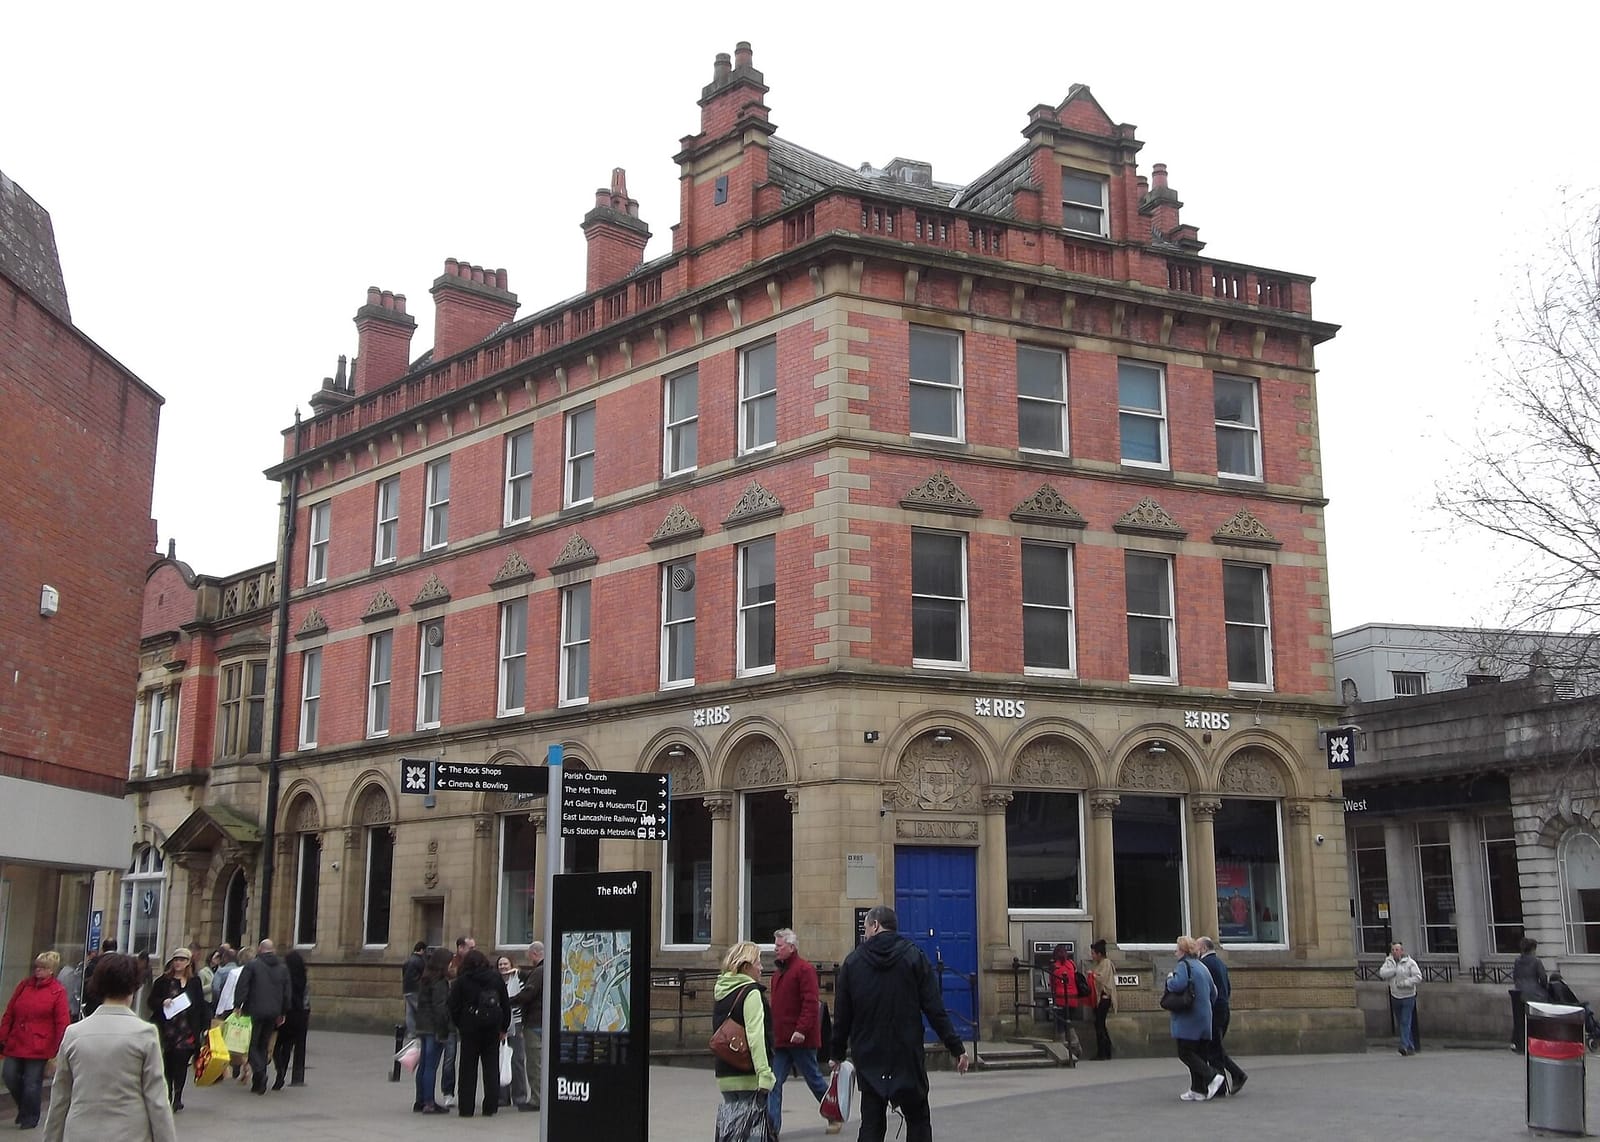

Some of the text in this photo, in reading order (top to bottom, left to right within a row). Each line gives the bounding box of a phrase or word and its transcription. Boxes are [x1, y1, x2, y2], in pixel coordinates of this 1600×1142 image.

[993, 698, 1026, 718] RBS
[706, 705, 731, 725] RBS
[1201, 711, 1230, 730] RBS
[448, 765, 502, 776] The Rock Shops
[564, 772, 608, 781] Parish Church
[448, 780, 474, 788] Cinema
[482, 781, 509, 791] Bowling
[578, 786, 591, 794] Met
[592, 787, 617, 795] Theatre
[563, 799, 574, 807] Art
[575, 800, 598, 809] Gallery
[605, 801, 636, 809] Museums
[1344, 799, 1368, 811] West
[562, 813, 638, 824] East Lancashire Railway
[576, 827, 599, 835] Station
[606, 828, 636, 836] Metrolink
[914, 822, 961, 837] BANK
[597, 885, 632, 895] The Rock
[1117, 976, 1137, 984] ROCK
[557, 1077, 590, 1102] Bury
